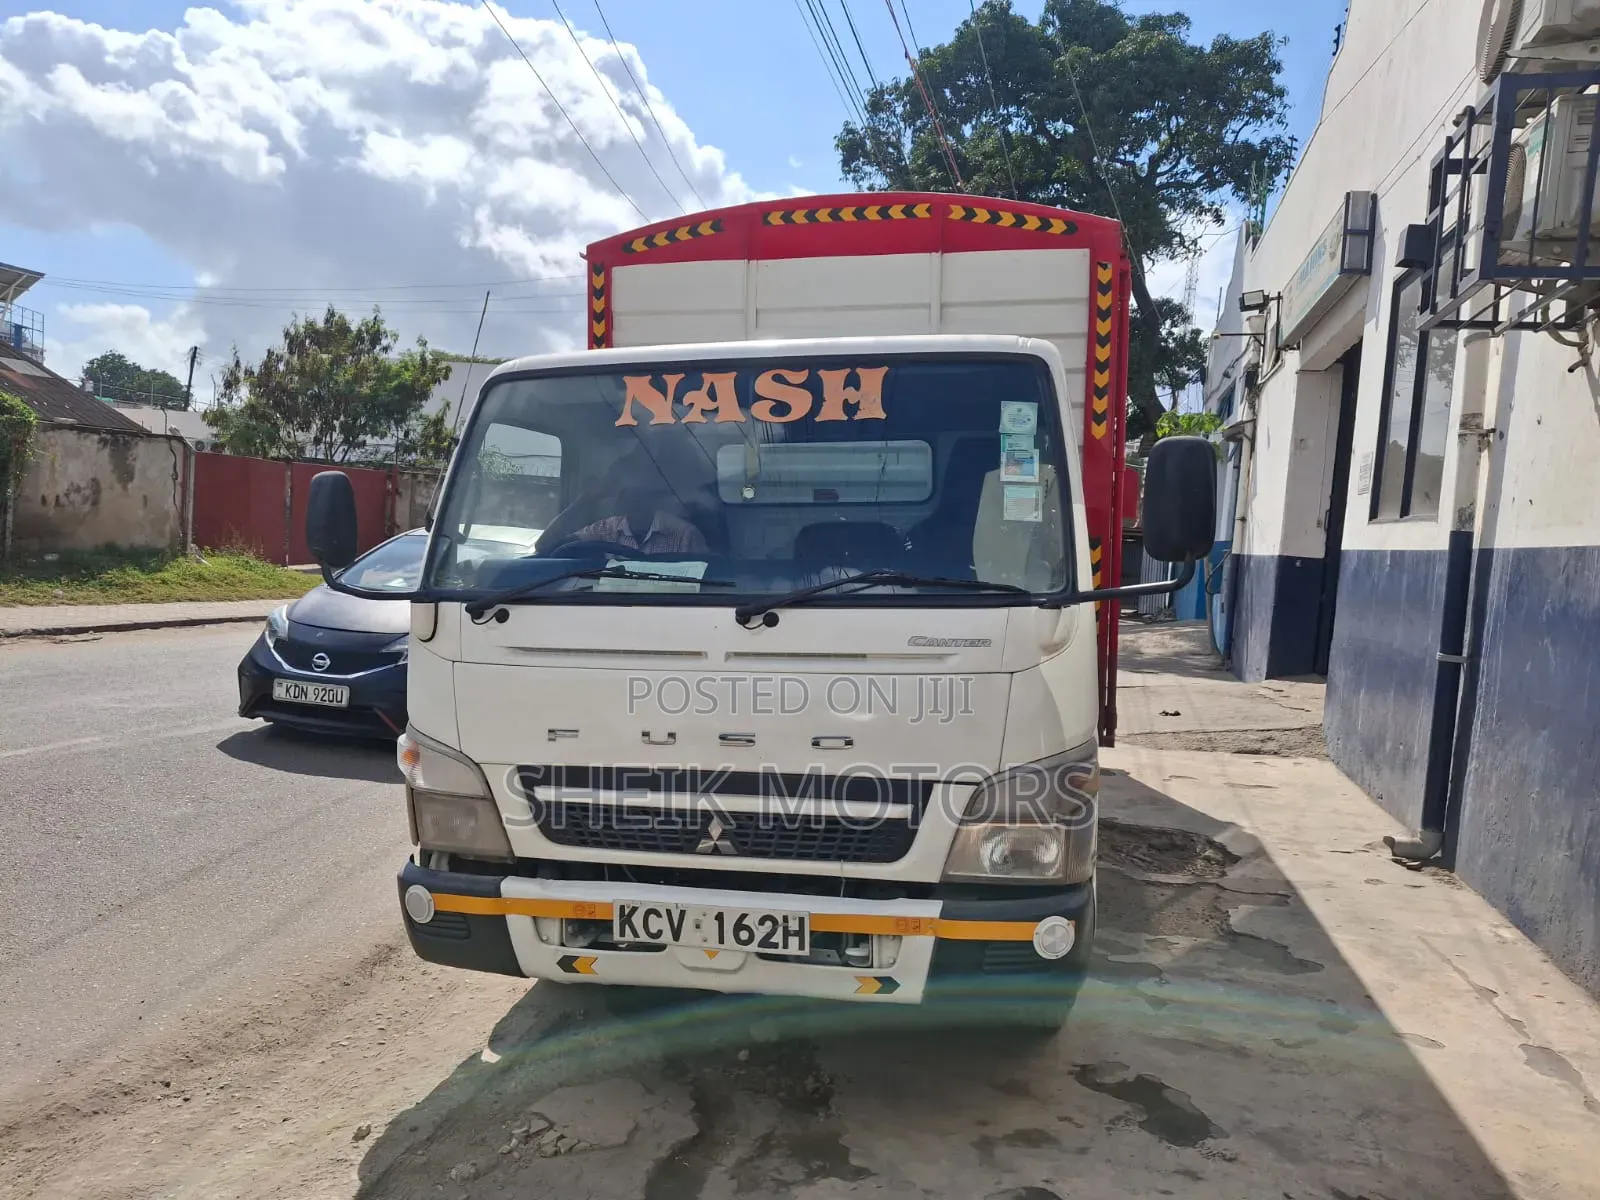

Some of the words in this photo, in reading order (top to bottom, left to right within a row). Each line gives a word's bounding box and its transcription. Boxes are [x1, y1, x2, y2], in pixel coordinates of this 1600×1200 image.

[615, 366, 890, 427] NASH
[285, 684, 308, 701] KDN
[313, 687, 343, 704] 920U
[547, 727, 854, 750] FUSO
[618, 904, 687, 943] KCV
[714, 911, 806, 952] 162H
